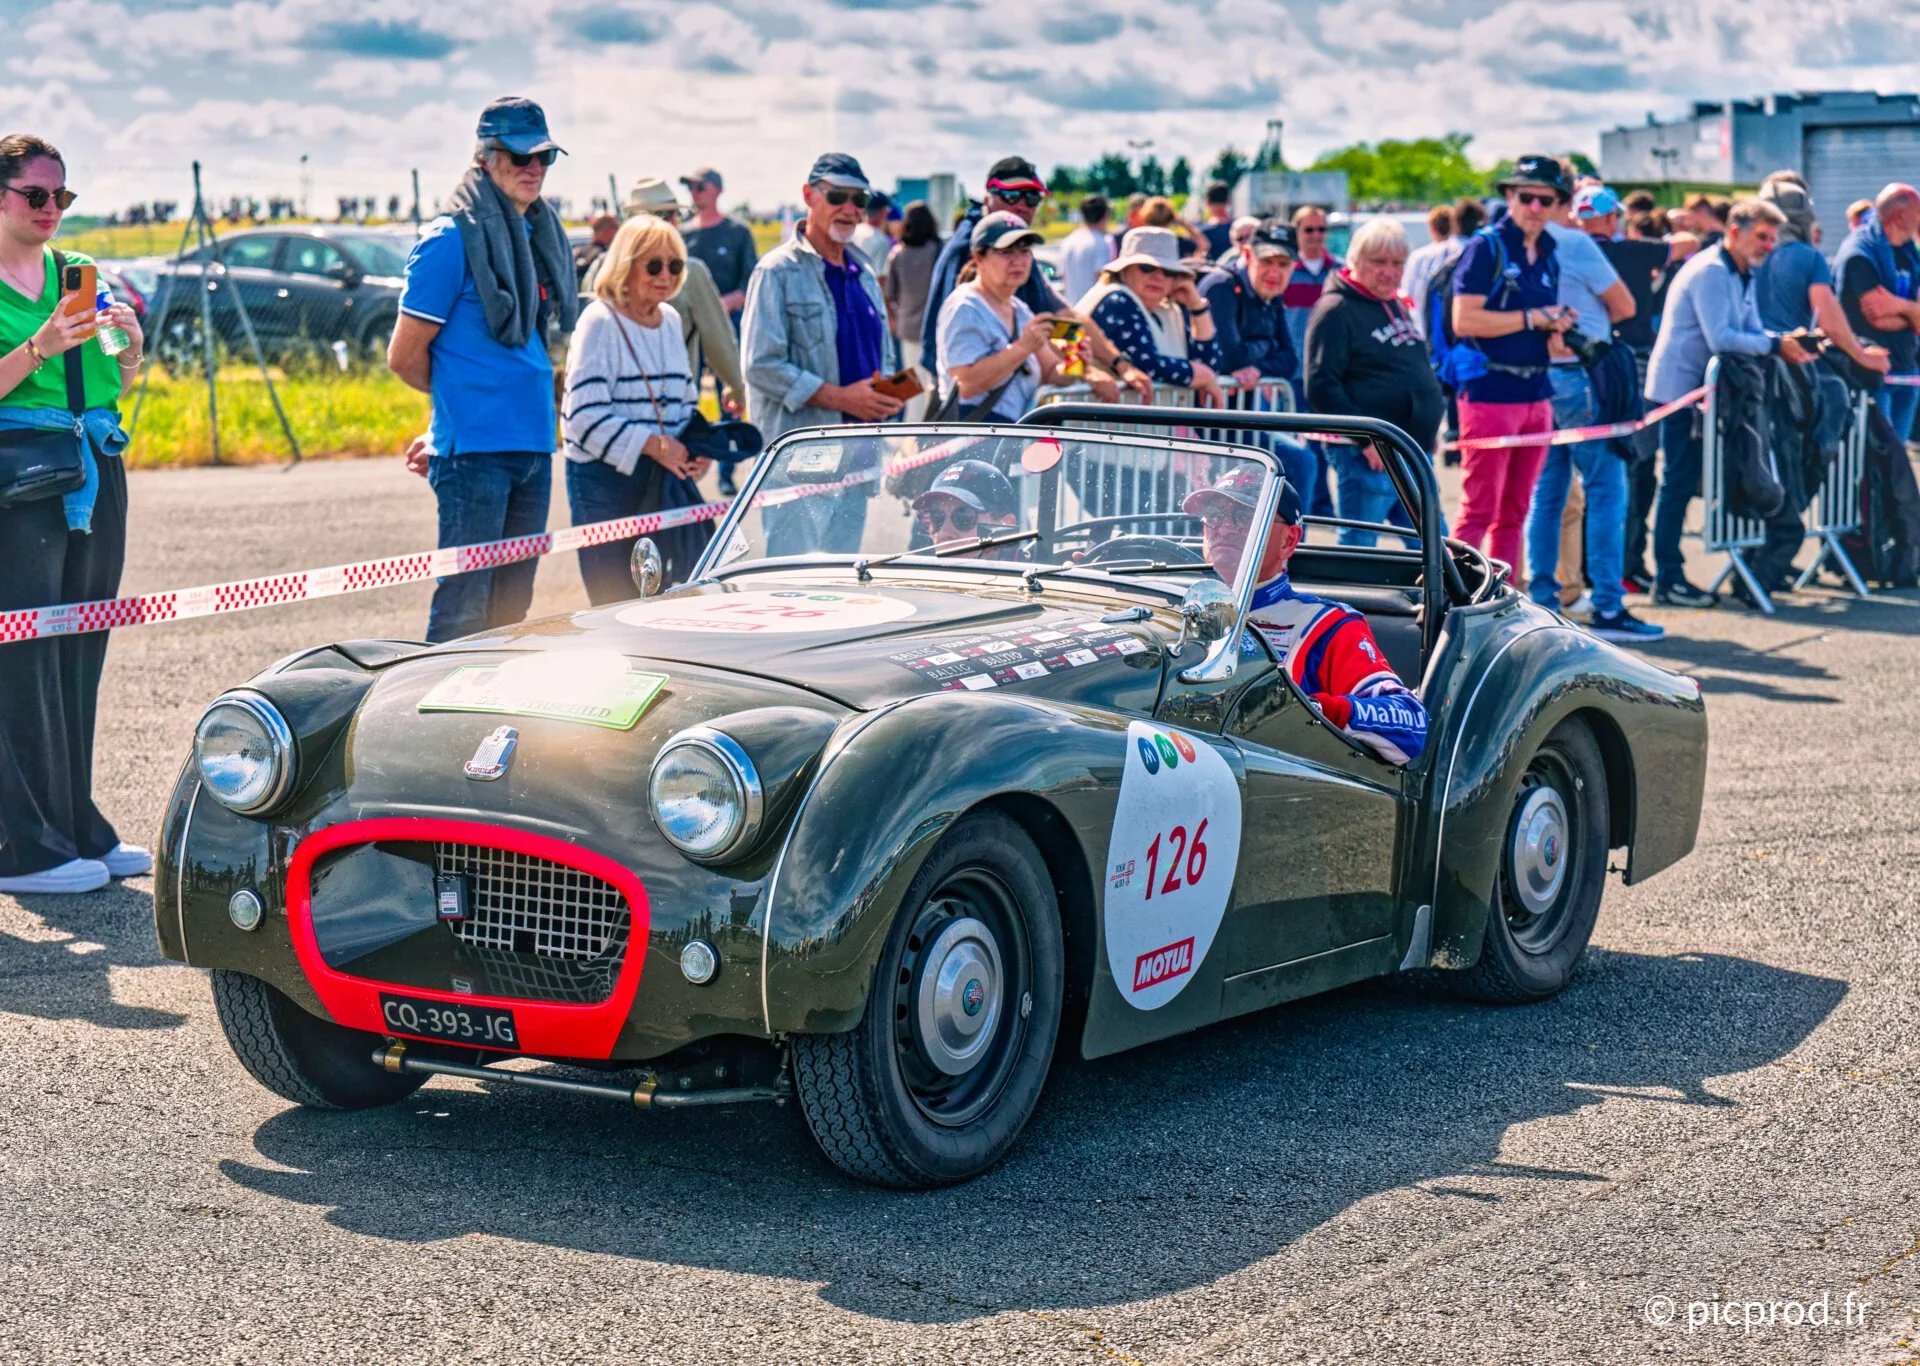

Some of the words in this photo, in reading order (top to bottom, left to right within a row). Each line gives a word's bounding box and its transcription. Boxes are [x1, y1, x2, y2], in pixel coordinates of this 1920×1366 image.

[702, 603, 839, 618] 126
[889, 646, 938, 661] BALTIC
[926, 663, 972, 679] BALTIC
[1145, 817, 1209, 901] 126
[1115, 862, 1126, 873] TOUR
[1114, 878, 1125, 889] AUTO
[1136, 943, 1190, 986] MOTUL
[383, 1001, 514, 1042] CQ-393-JG
